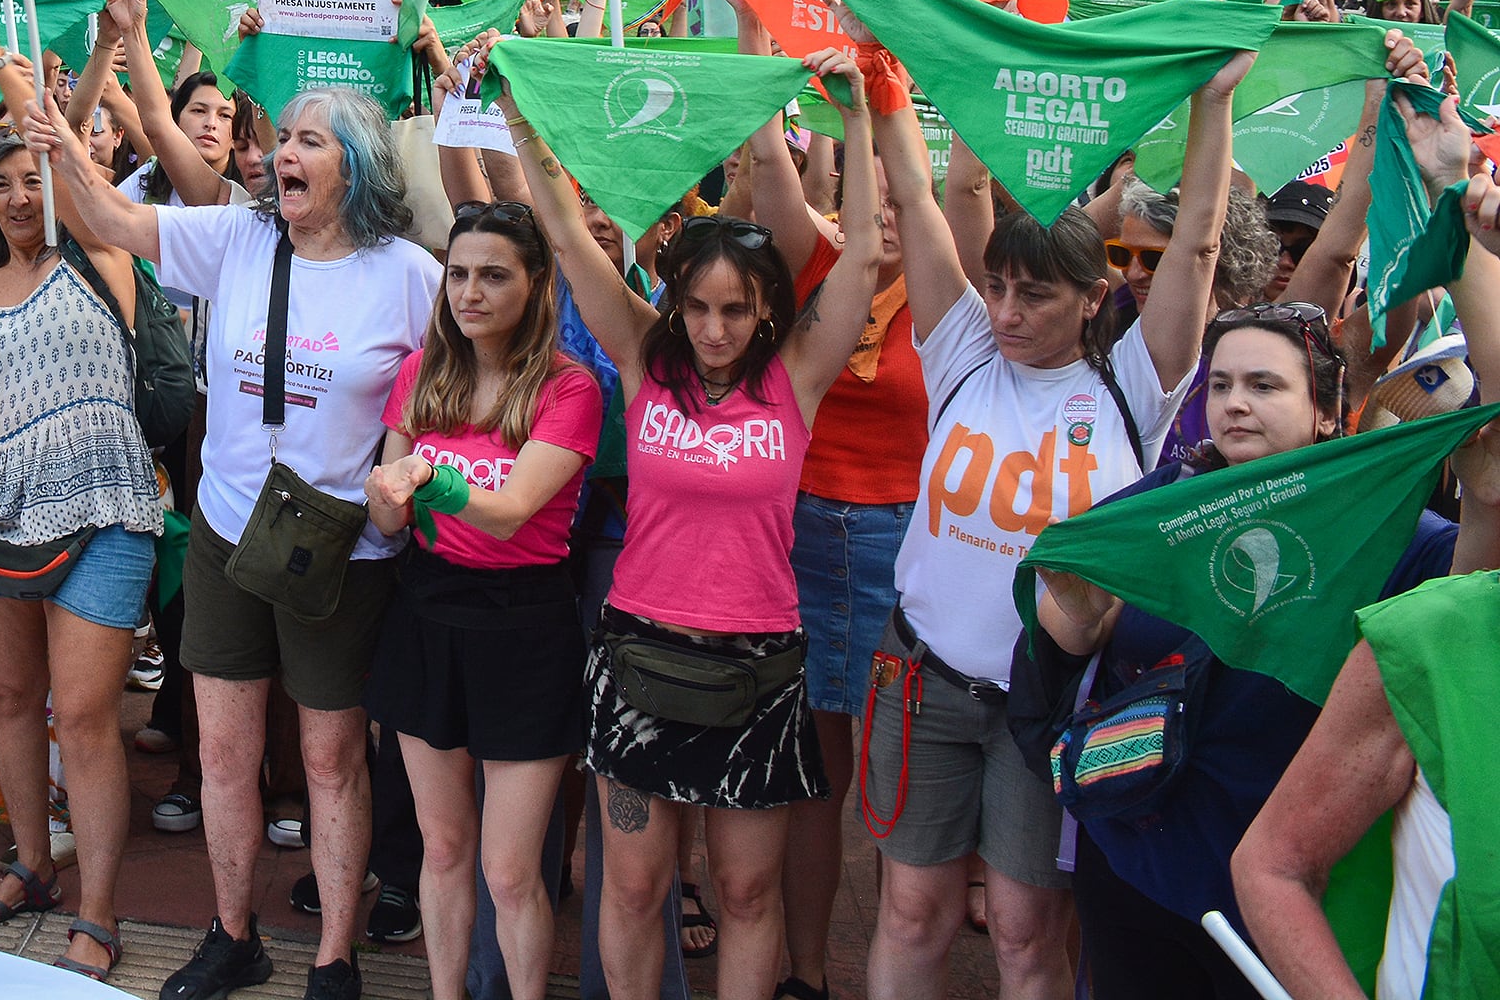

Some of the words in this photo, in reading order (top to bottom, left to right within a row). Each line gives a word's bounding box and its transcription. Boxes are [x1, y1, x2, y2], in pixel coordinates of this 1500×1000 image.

[278, 9, 373, 23] www.libertadparapaola.org
[304, 0, 376, 11] INJUSTAMENTE
[296, 50, 306, 76] 27.610
[308, 51, 362, 67] LEGAL,
[306, 67, 375, 82] SEGURO,
[993, 68, 1126, 102] ABORTO
[460, 105, 476, 114] PRESA
[1005, 94, 1109, 128] LEGAL
[942, 129, 947, 140] Y
[1004, 119, 1046, 139] SEGURO
[1048, 124, 1055, 140] Y
[1056, 125, 1109, 145] GRATUITO
[1271, 126, 1287, 134] para
[1300, 134, 1317, 146] morir
[1026, 144, 1073, 176] pdt
[286, 362, 333, 381] ORTÍZ!
[639, 400, 786, 468] ISADORA
[412, 442, 517, 492] ISADOR
[667, 450, 679, 459] EN
[684, 453, 714, 465] LUCHA
[928, 422, 1098, 537] pdt
[1158, 509, 1199, 533] Campaña
[1199, 492, 1238, 516] Nacional
[1239, 488, 1254, 501] Por
[1257, 482, 1264, 494] el
[1266, 472, 1305, 491] Derecho
[1166, 534, 1174, 547] al
[1176, 524, 1204, 543] Aborto
[1204, 511, 1232, 530] Legal,
[1231, 500, 1262, 518] Seguro
[1263, 497, 1270, 510] y
[1270, 483, 1307, 503] Gratuito
[949, 524, 996, 552] Plenario
[1000, 542, 1014, 555] de
